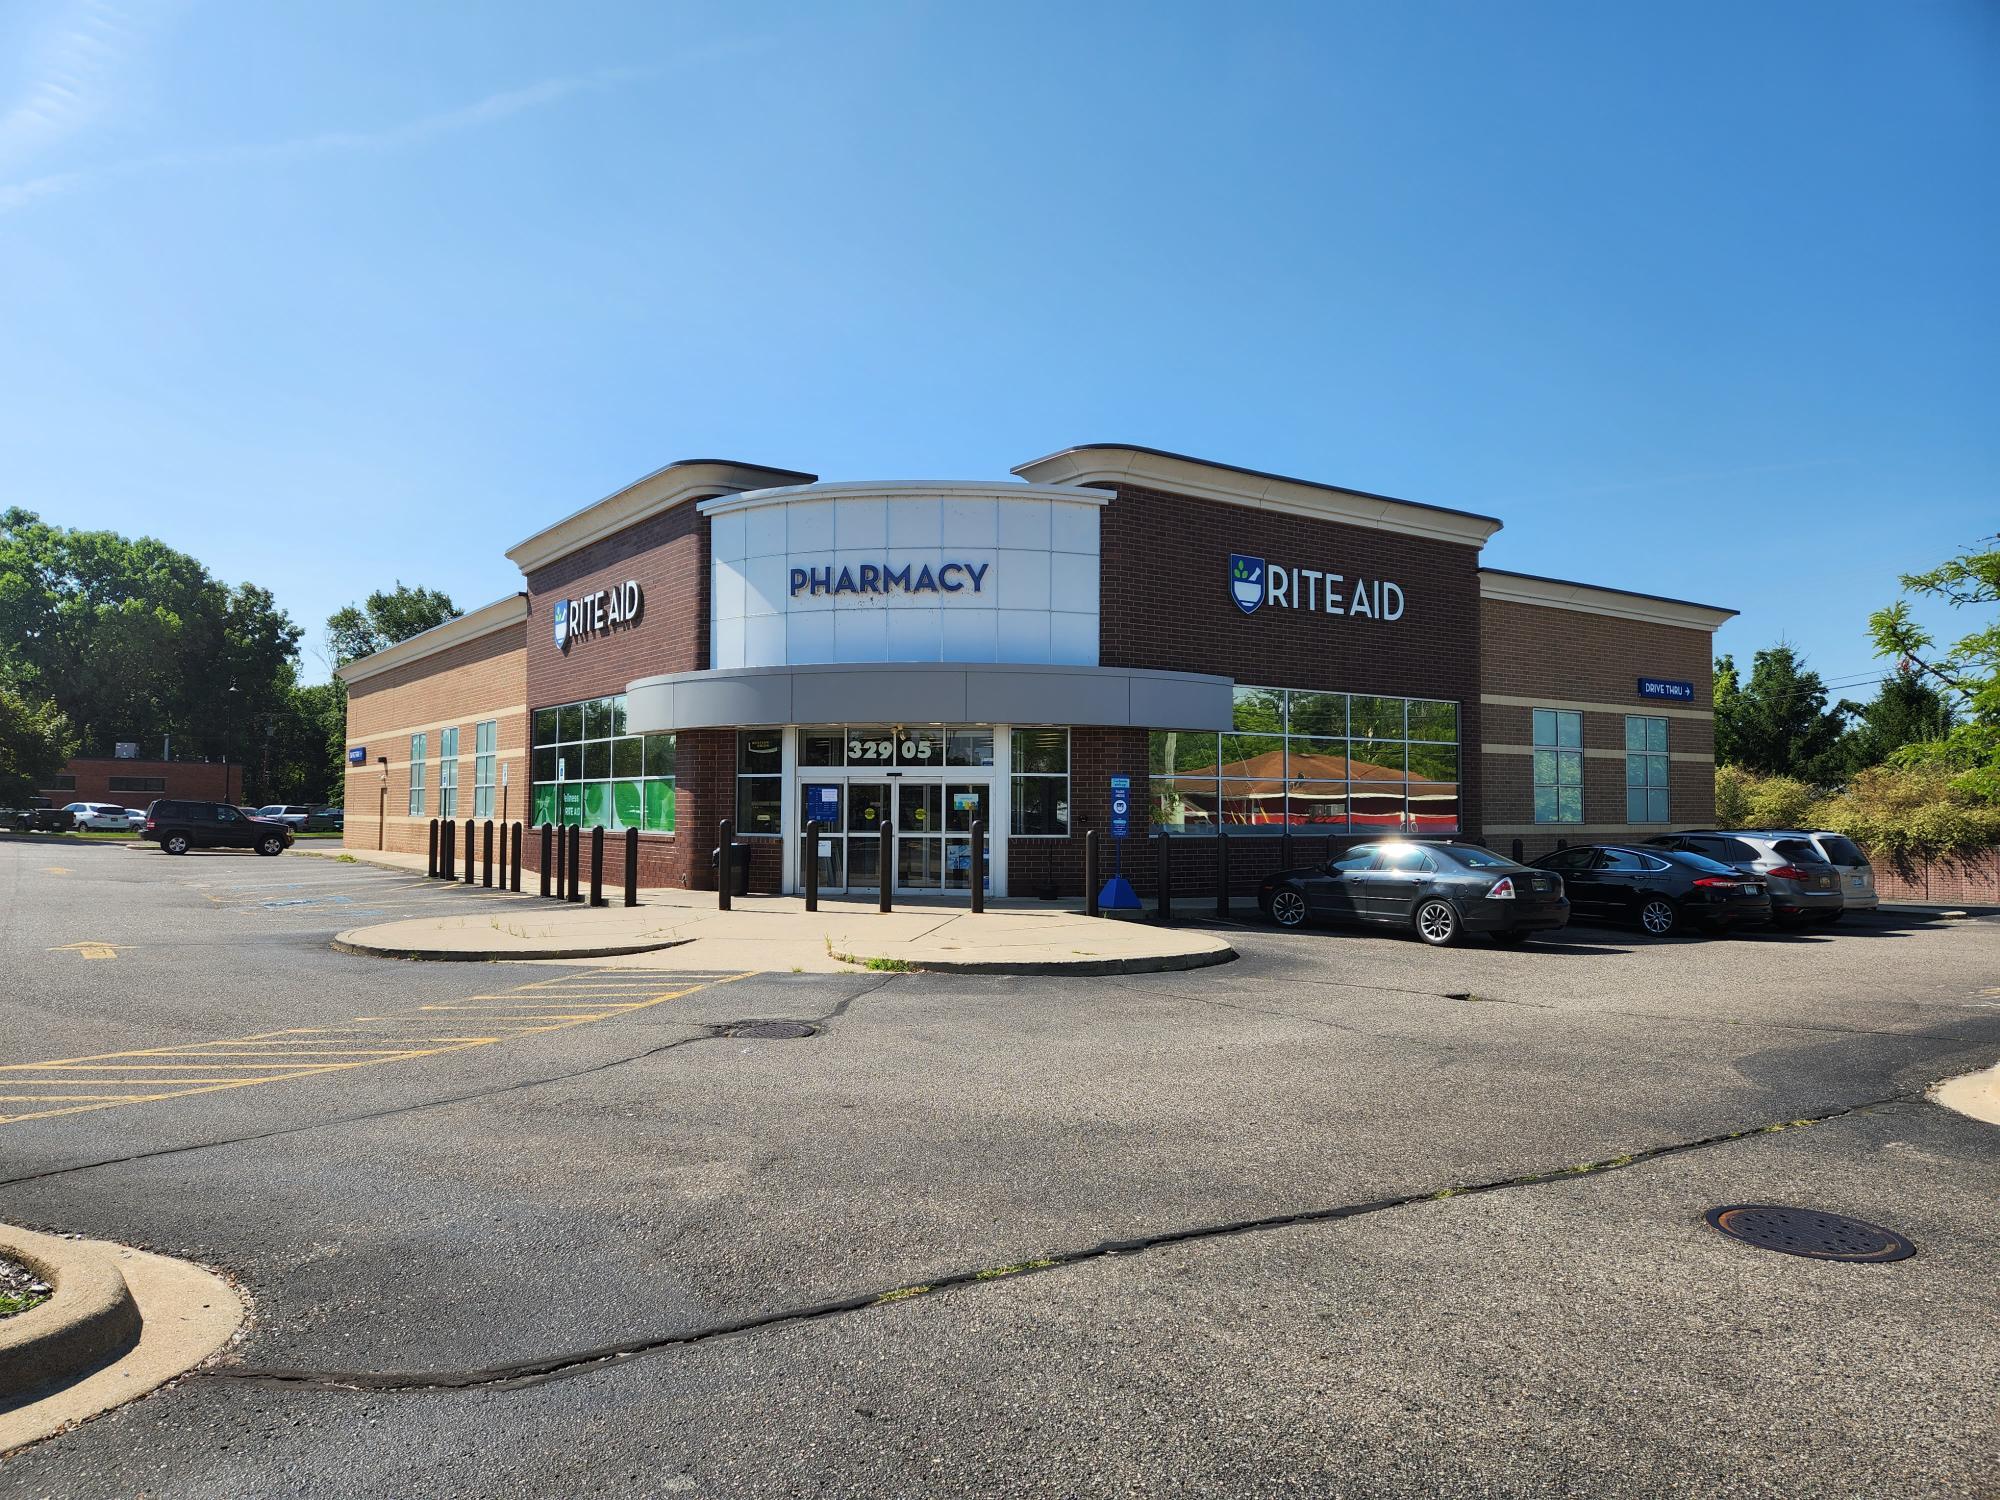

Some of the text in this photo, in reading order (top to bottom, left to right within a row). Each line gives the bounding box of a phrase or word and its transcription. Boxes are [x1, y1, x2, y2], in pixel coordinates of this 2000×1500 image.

[790, 563, 989, 596] PHARMACY
[1267, 564, 1405, 621] RITE AID
[569, 580, 639, 637] RITE AID
[1645, 683, 1682, 695] DRIVE THRU
